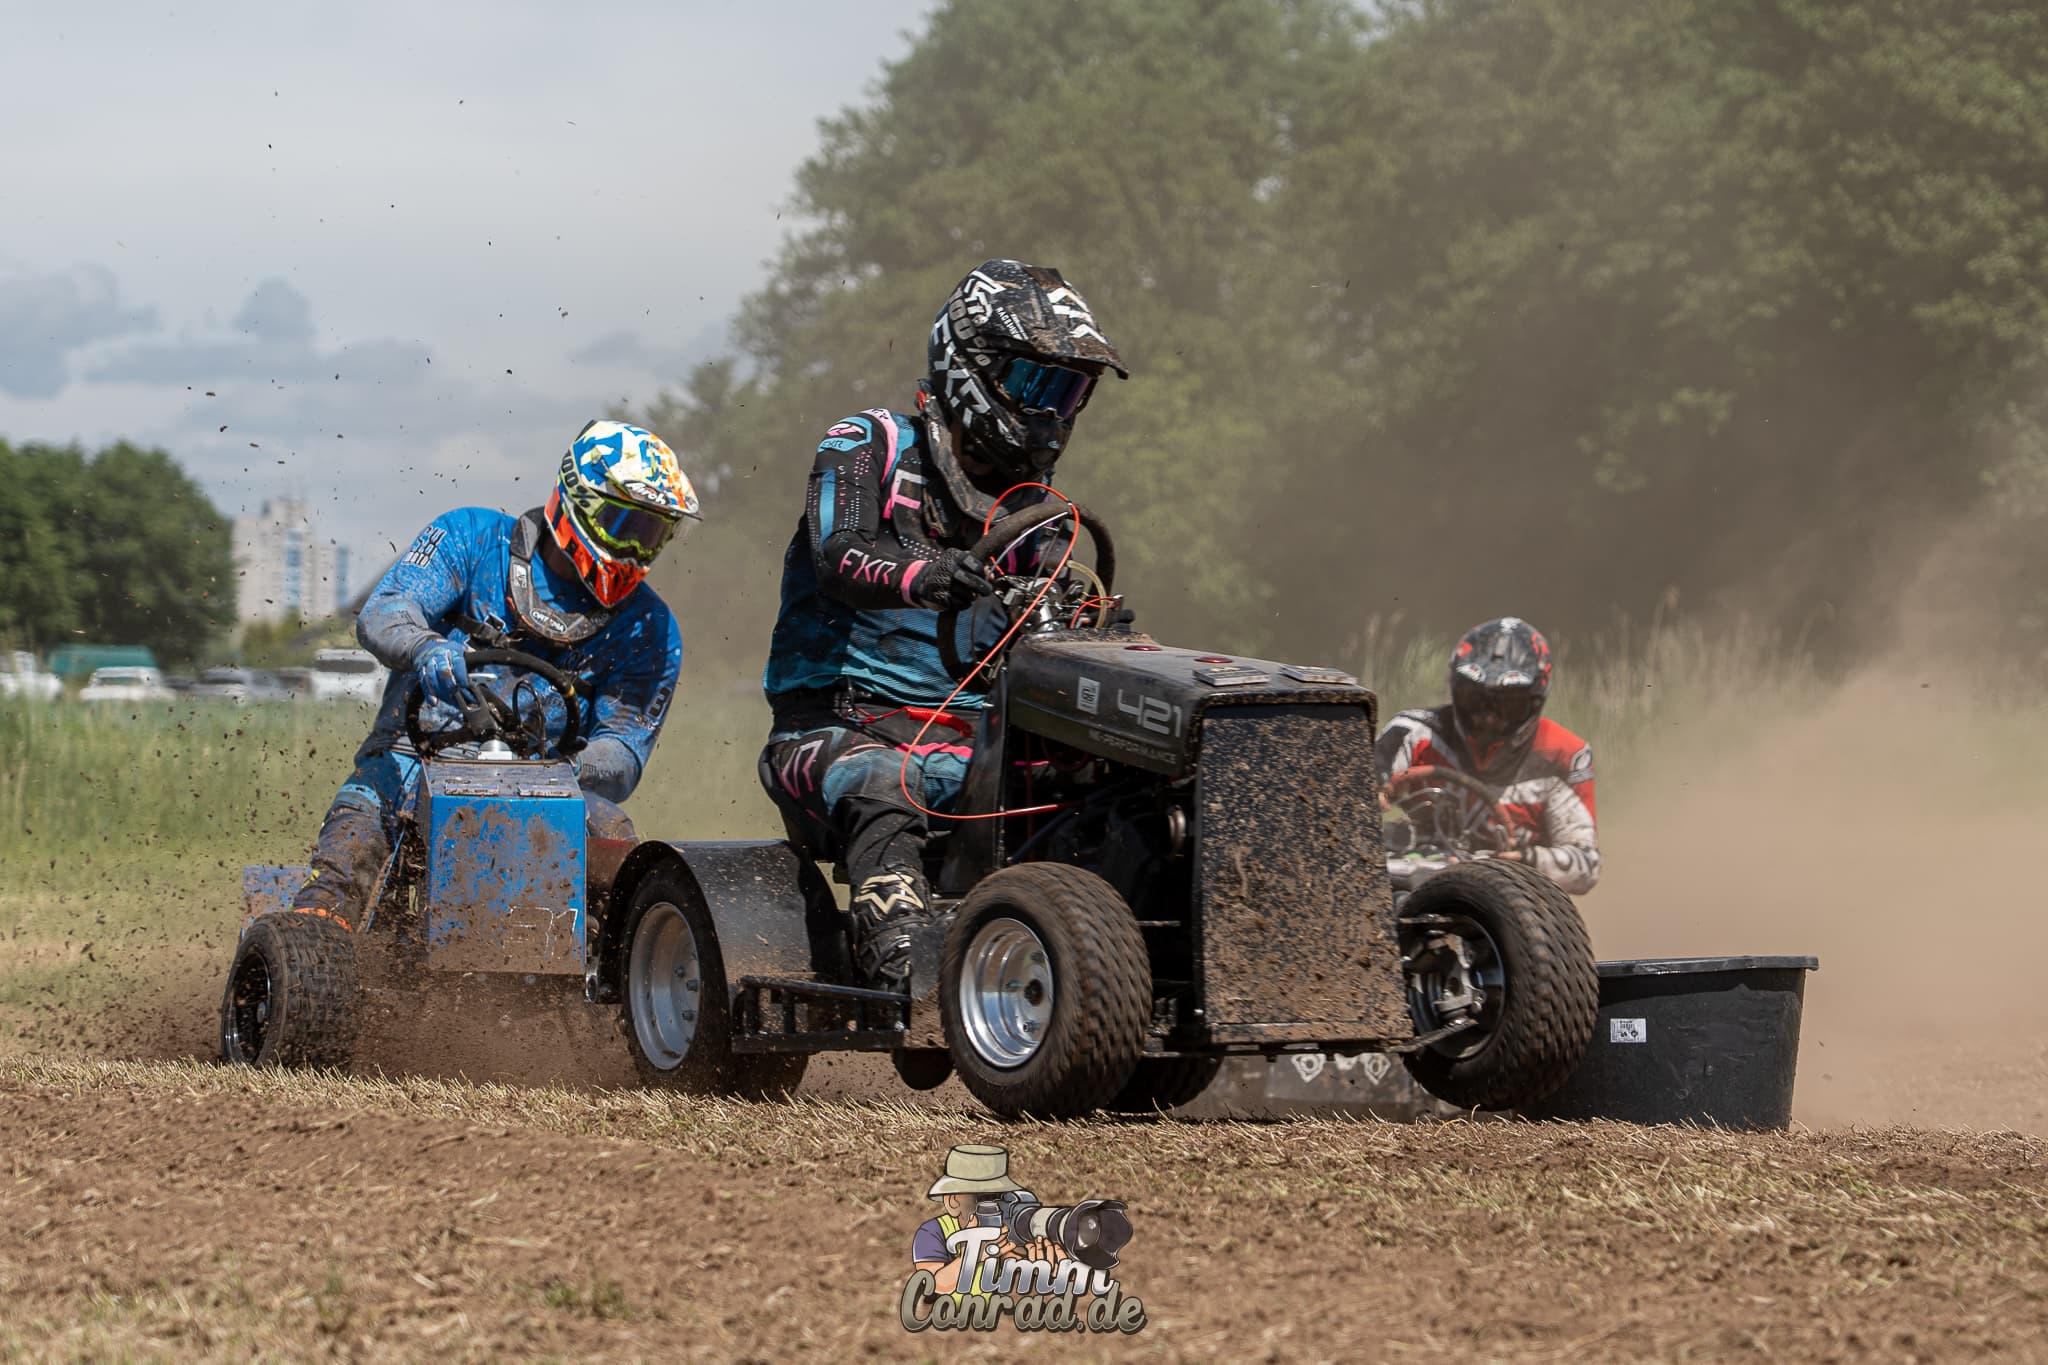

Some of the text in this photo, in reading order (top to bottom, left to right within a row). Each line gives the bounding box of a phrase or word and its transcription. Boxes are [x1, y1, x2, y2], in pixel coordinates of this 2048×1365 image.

[624, 481, 667, 506] Airoh
[838, 548, 898, 585] FXR
[1117, 688, 1182, 738] 421
